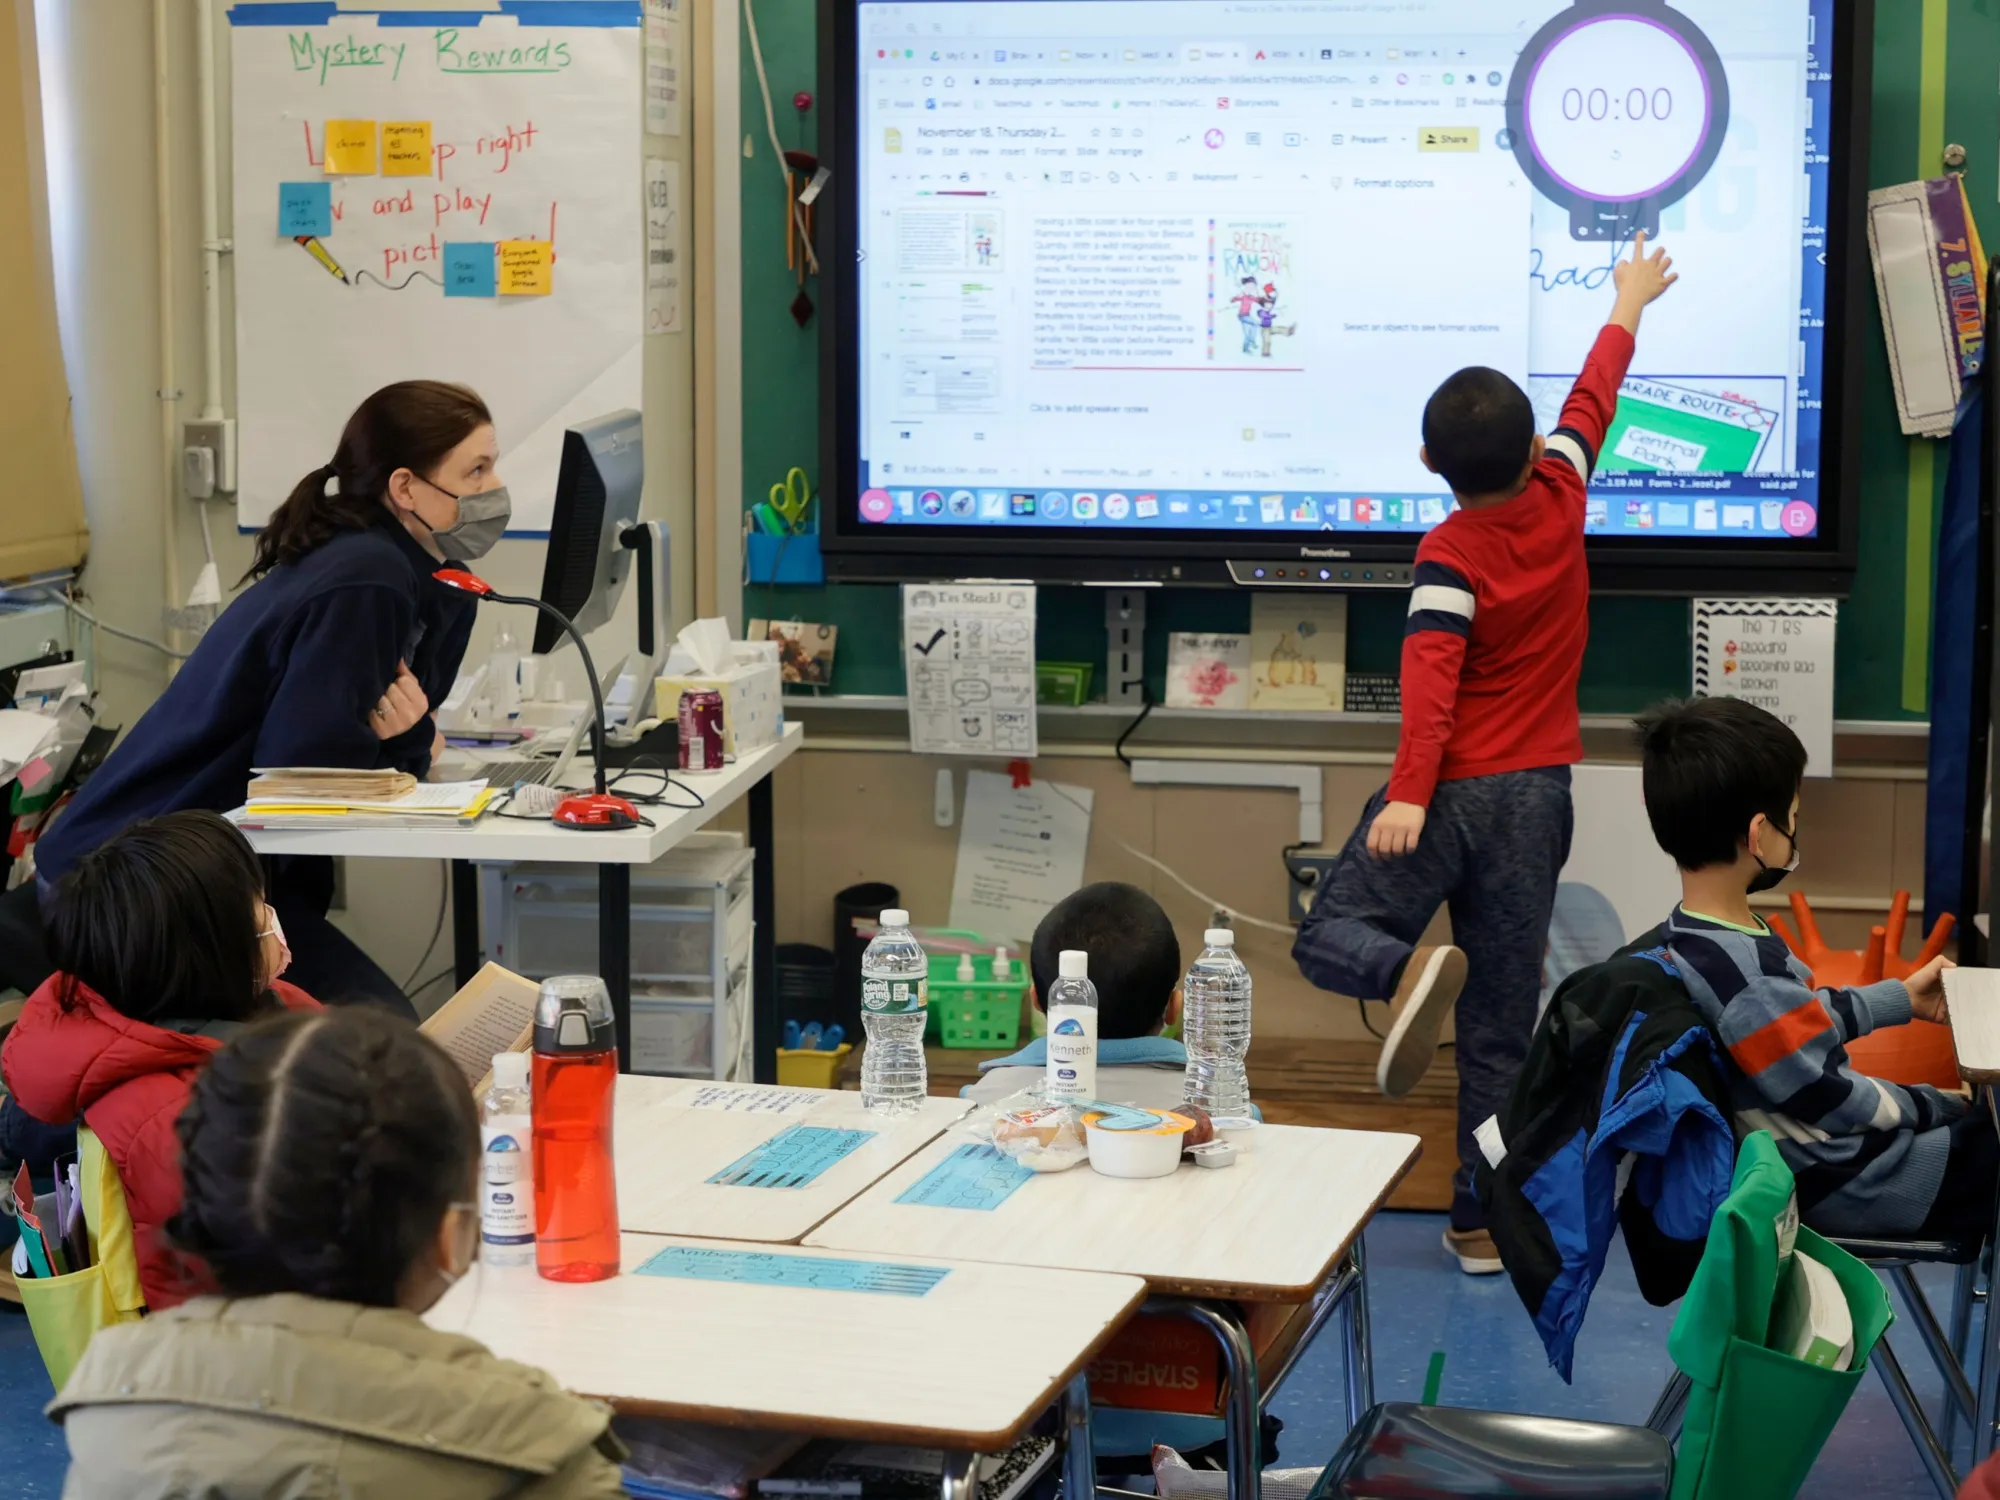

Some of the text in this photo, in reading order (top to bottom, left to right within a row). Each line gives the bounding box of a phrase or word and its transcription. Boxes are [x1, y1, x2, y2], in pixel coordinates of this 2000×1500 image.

[290, 28, 572, 85] Mystery Rewards
[1562, 88, 1673, 120] 00:00
[918, 127, 977, 138] November
[998, 126, 1048, 140] Thursday
[1351, 134, 1388, 144] Present
[1440, 134, 1468, 144] Share
[476, 121, 538, 173] right
[1354, 178, 1434, 190] Format options
[373, 187, 492, 226] and play
[1621, 381, 1676, 403] ARADE
[1680, 394, 1736, 418] ROUTE
[1030, 404, 1051, 413] Click
[1626, 427, 1700, 459] Central
[1632, 446, 1678, 470] Park
[1284, 466, 1326, 476] Numbers
[1770, 620, 1777, 634] 7
[863, 980, 888, 992] Poland
[864, 992, 890, 1004] Spring
[1050, 1042, 1092, 1056] Kenneth
